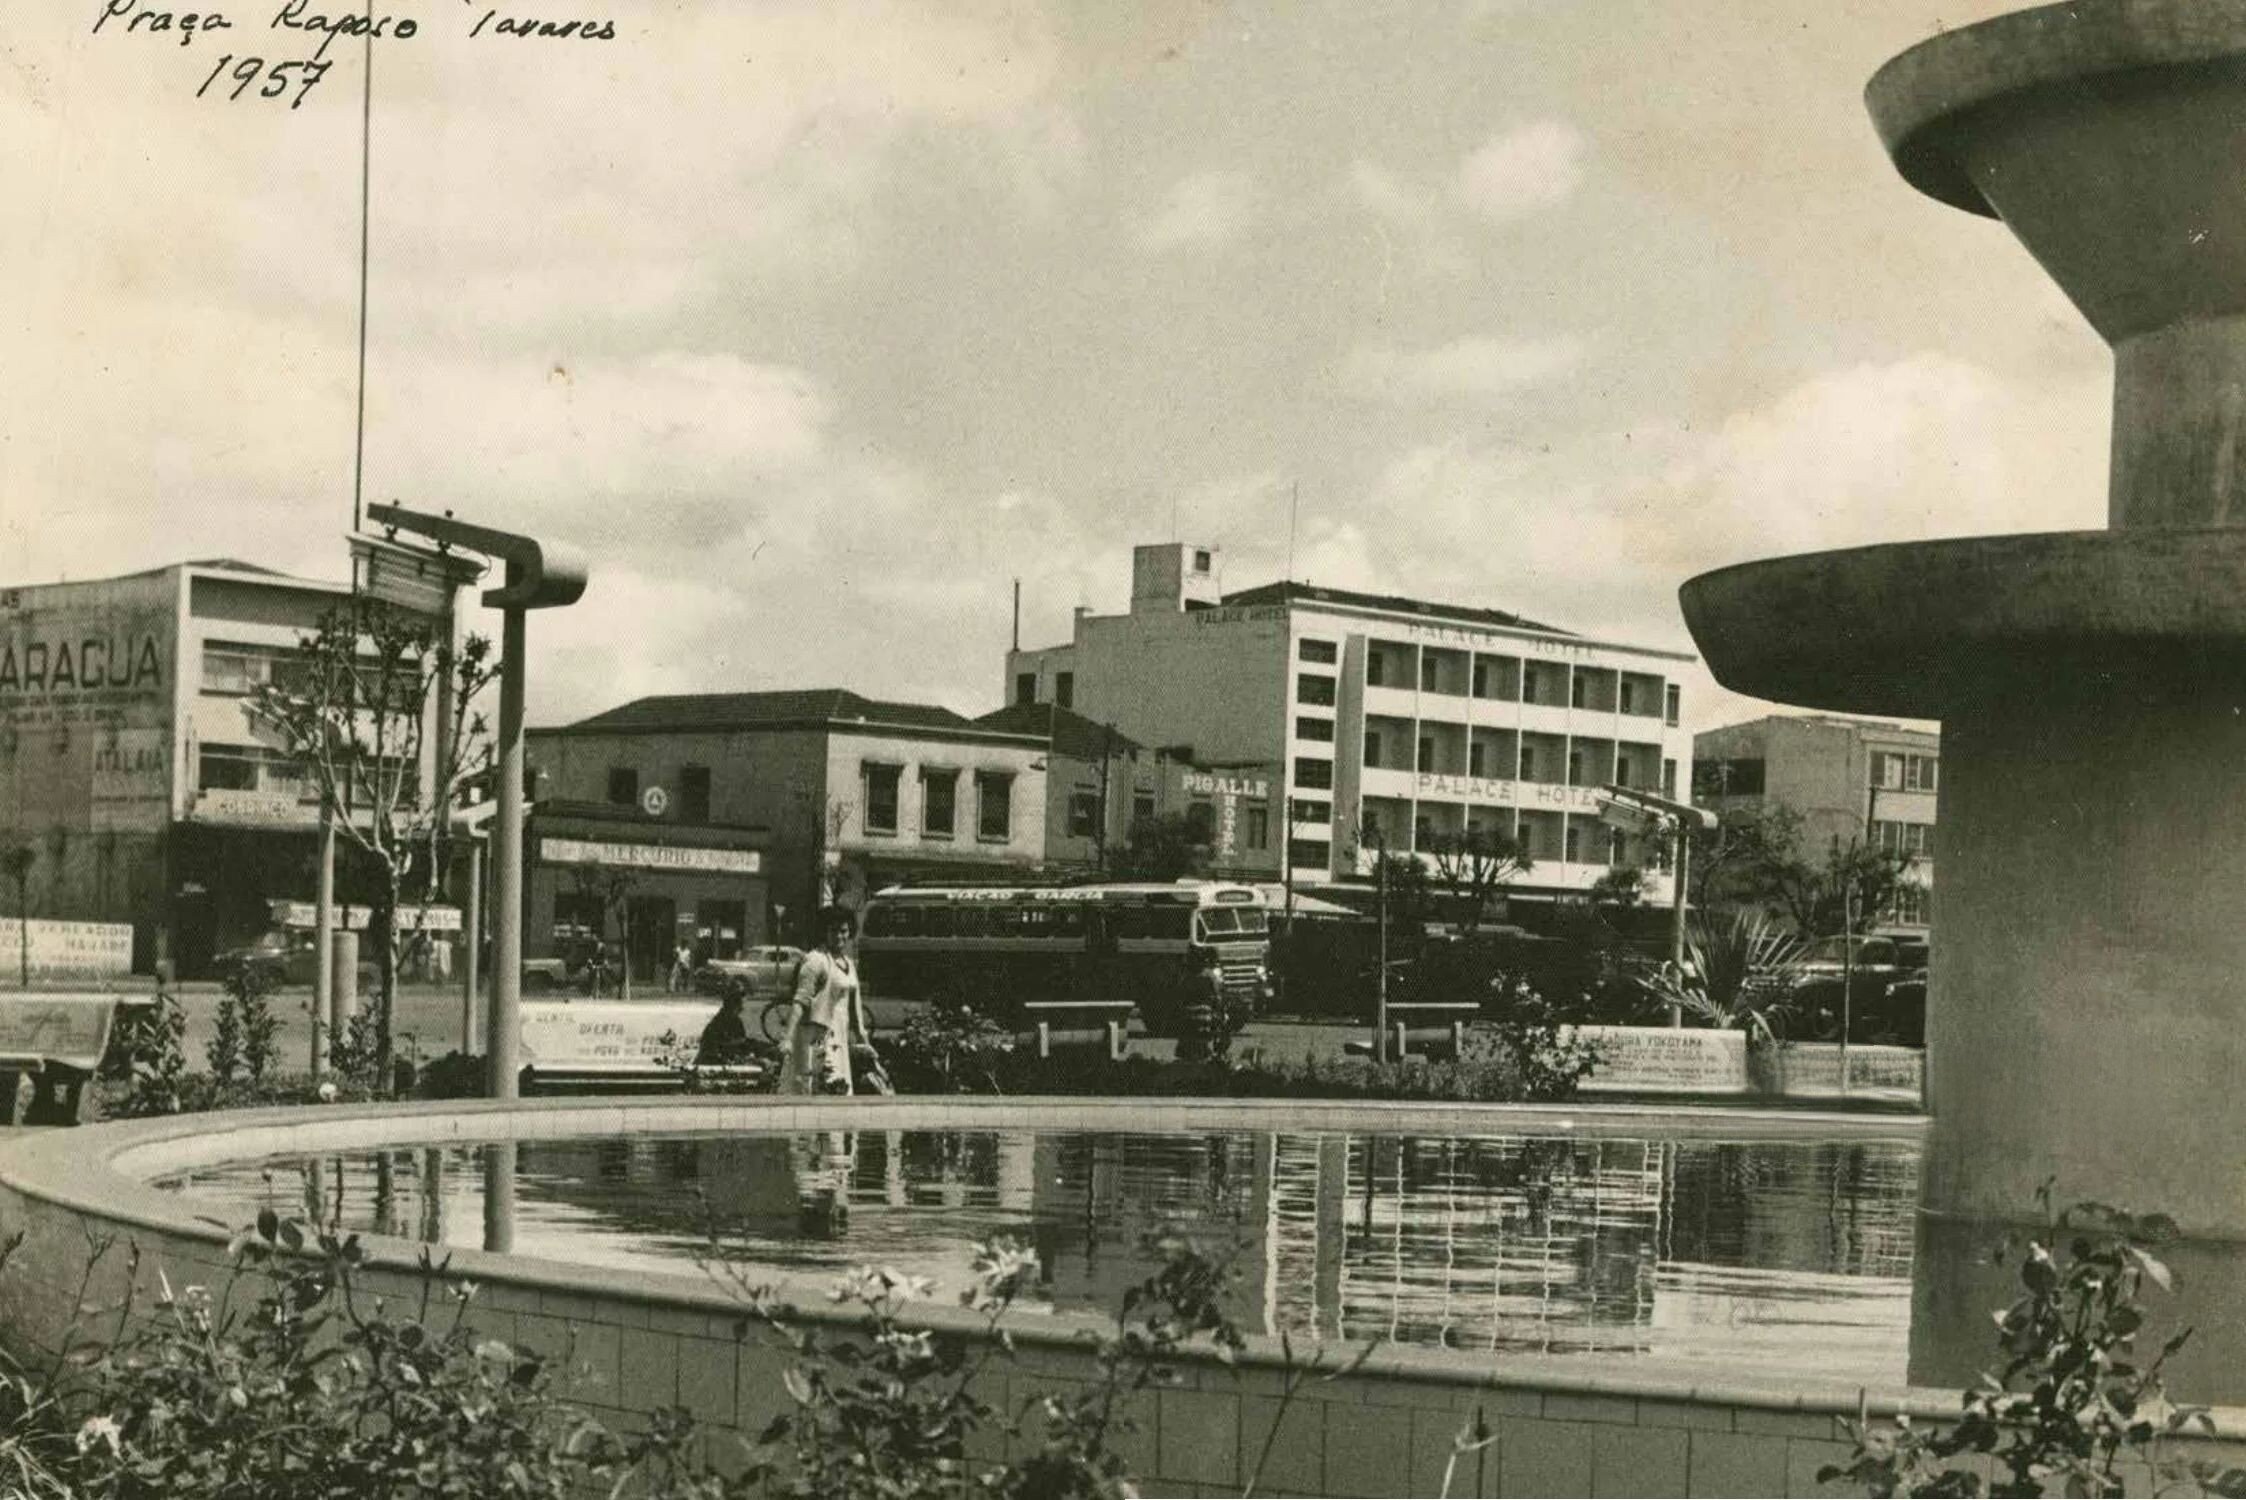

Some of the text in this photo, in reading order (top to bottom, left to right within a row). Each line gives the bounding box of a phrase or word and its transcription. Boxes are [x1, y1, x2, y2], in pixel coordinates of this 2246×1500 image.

[92, 0, 616, 60] Praça Raposo Tavares
[195, 54, 333, 109] 1957
[1182, 774, 1268, 798] PIGALLE
[1418, 774, 1600, 808] PALACE HOTE
[1221, 795, 1238, 856] HOTEL
